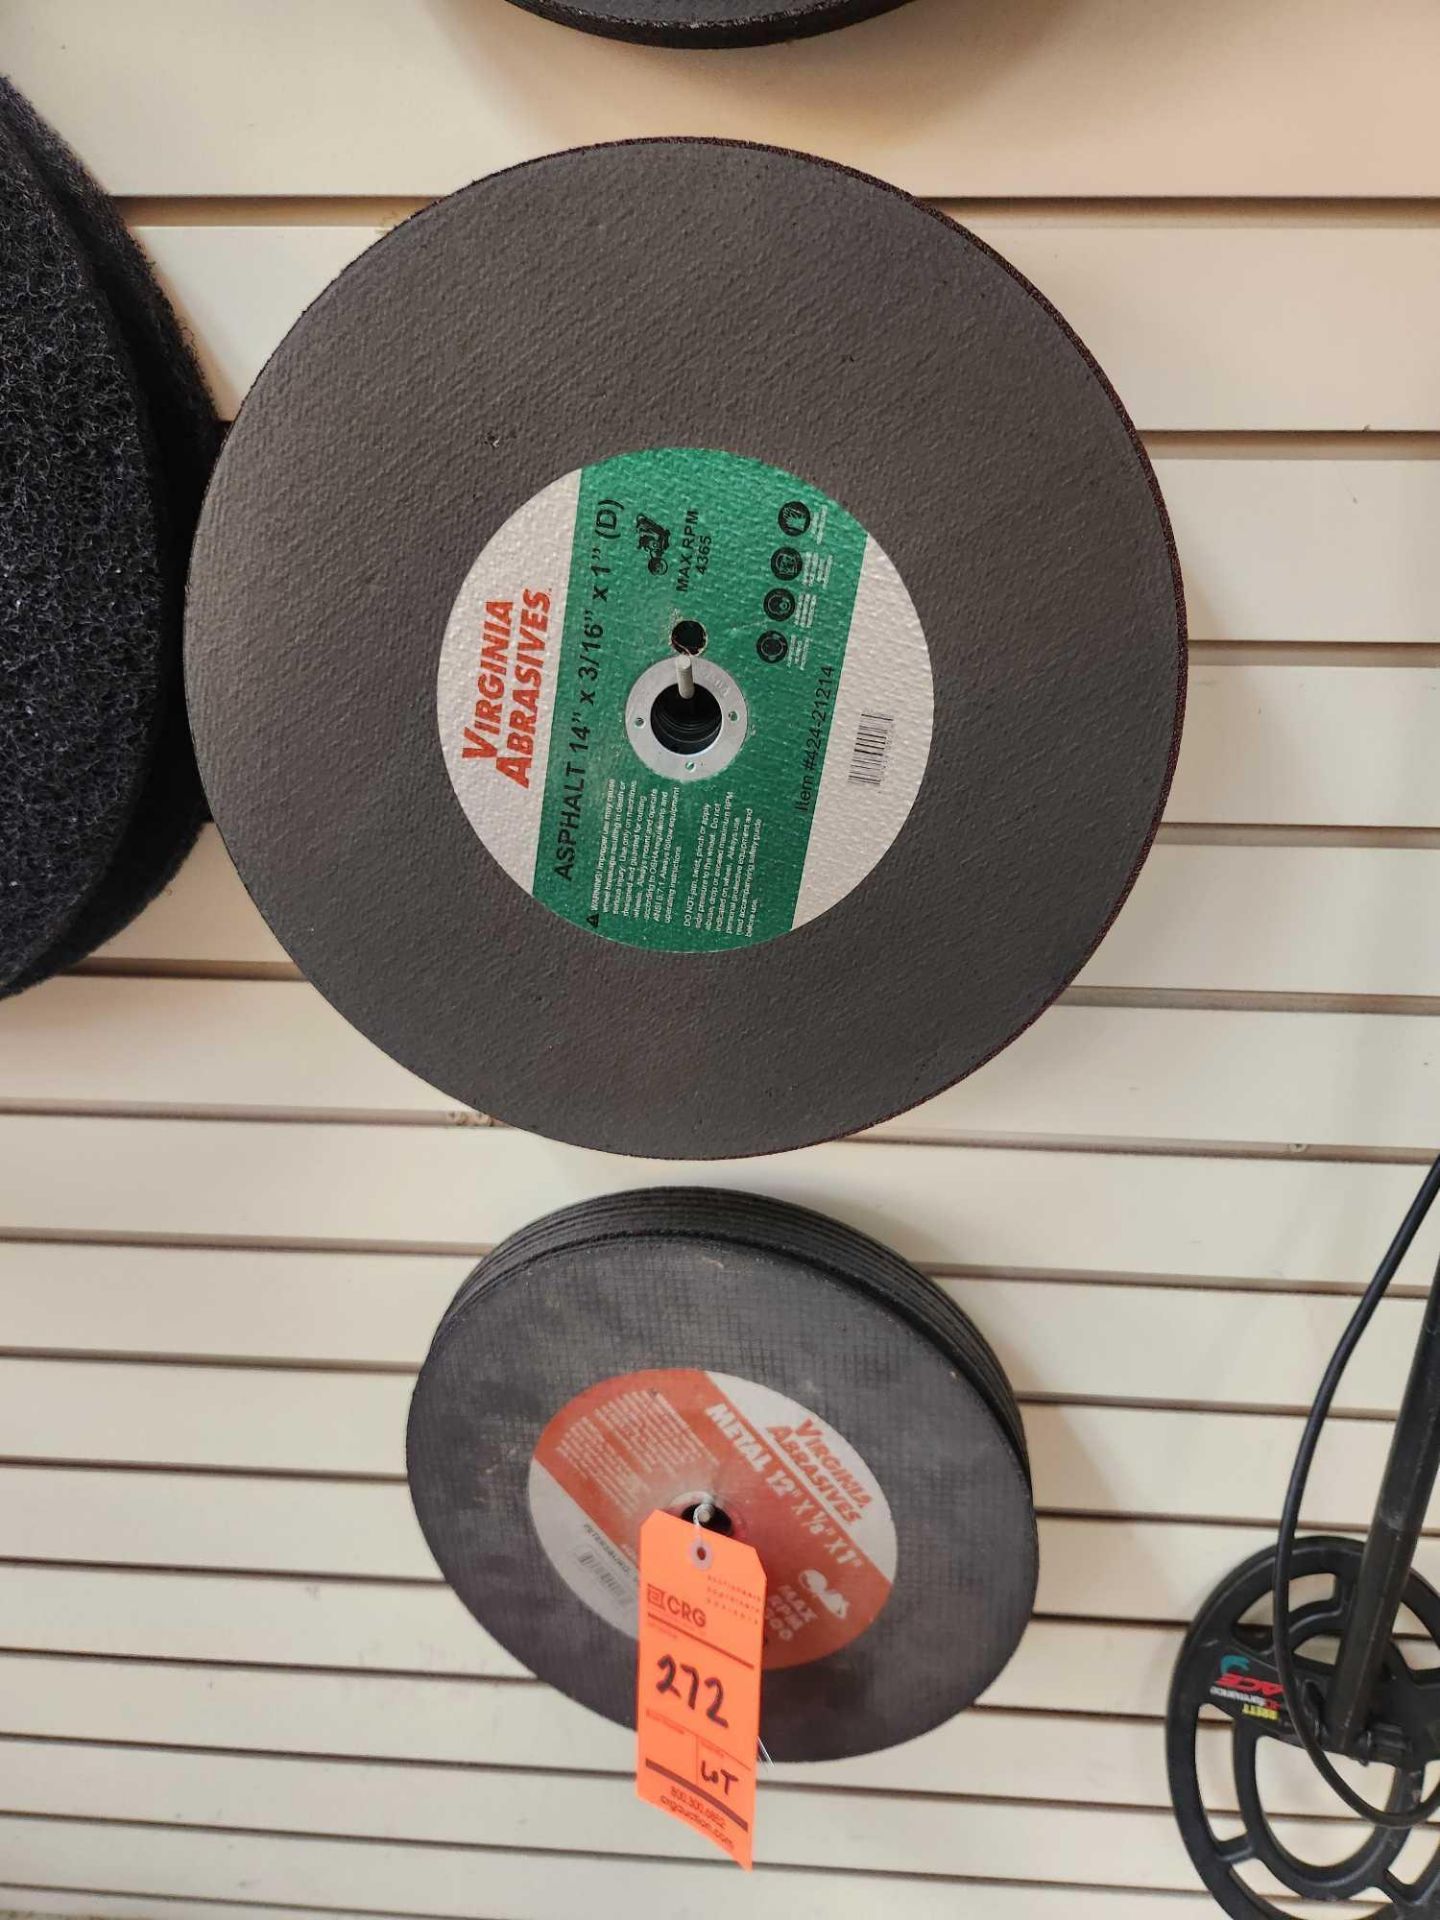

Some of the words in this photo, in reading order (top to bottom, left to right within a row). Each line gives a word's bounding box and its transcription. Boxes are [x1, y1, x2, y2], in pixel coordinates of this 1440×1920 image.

[593, 497, 625, 540] (D)
[681, 510, 698, 549] RPM
[675, 553, 692, 592] MAX
[694, 535, 711, 575] 4365
[593, 585, 610, 602] x
[576, 608, 605, 682] 3/16"
[461, 601, 513, 758] VIRGINIA
[495, 588, 551, 788] ABRASIVES
[580, 690, 597, 706] x
[569, 710, 592, 754] 14"
[802, 664, 834, 770] #424-21214
[794, 773, 814, 811] Item
[551, 760, 586, 881] ASPHALT
[684, 914, 691, 926] DO
[703, 1402, 773, 1474] METAL
[764, 1467, 803, 1498] 12"
[789, 1497, 815, 1517] X
[823, 1535, 848, 1555] X
[764, 1428, 862, 1523] ABRASIVES
[796, 1417, 872, 1508] VIRGINIA
[665, 1595, 708, 1628] CRG
[766, 1594, 804, 1631] RPM
[776, 1585, 818, 1623] MAX
[655, 1653, 729, 1729] 272
